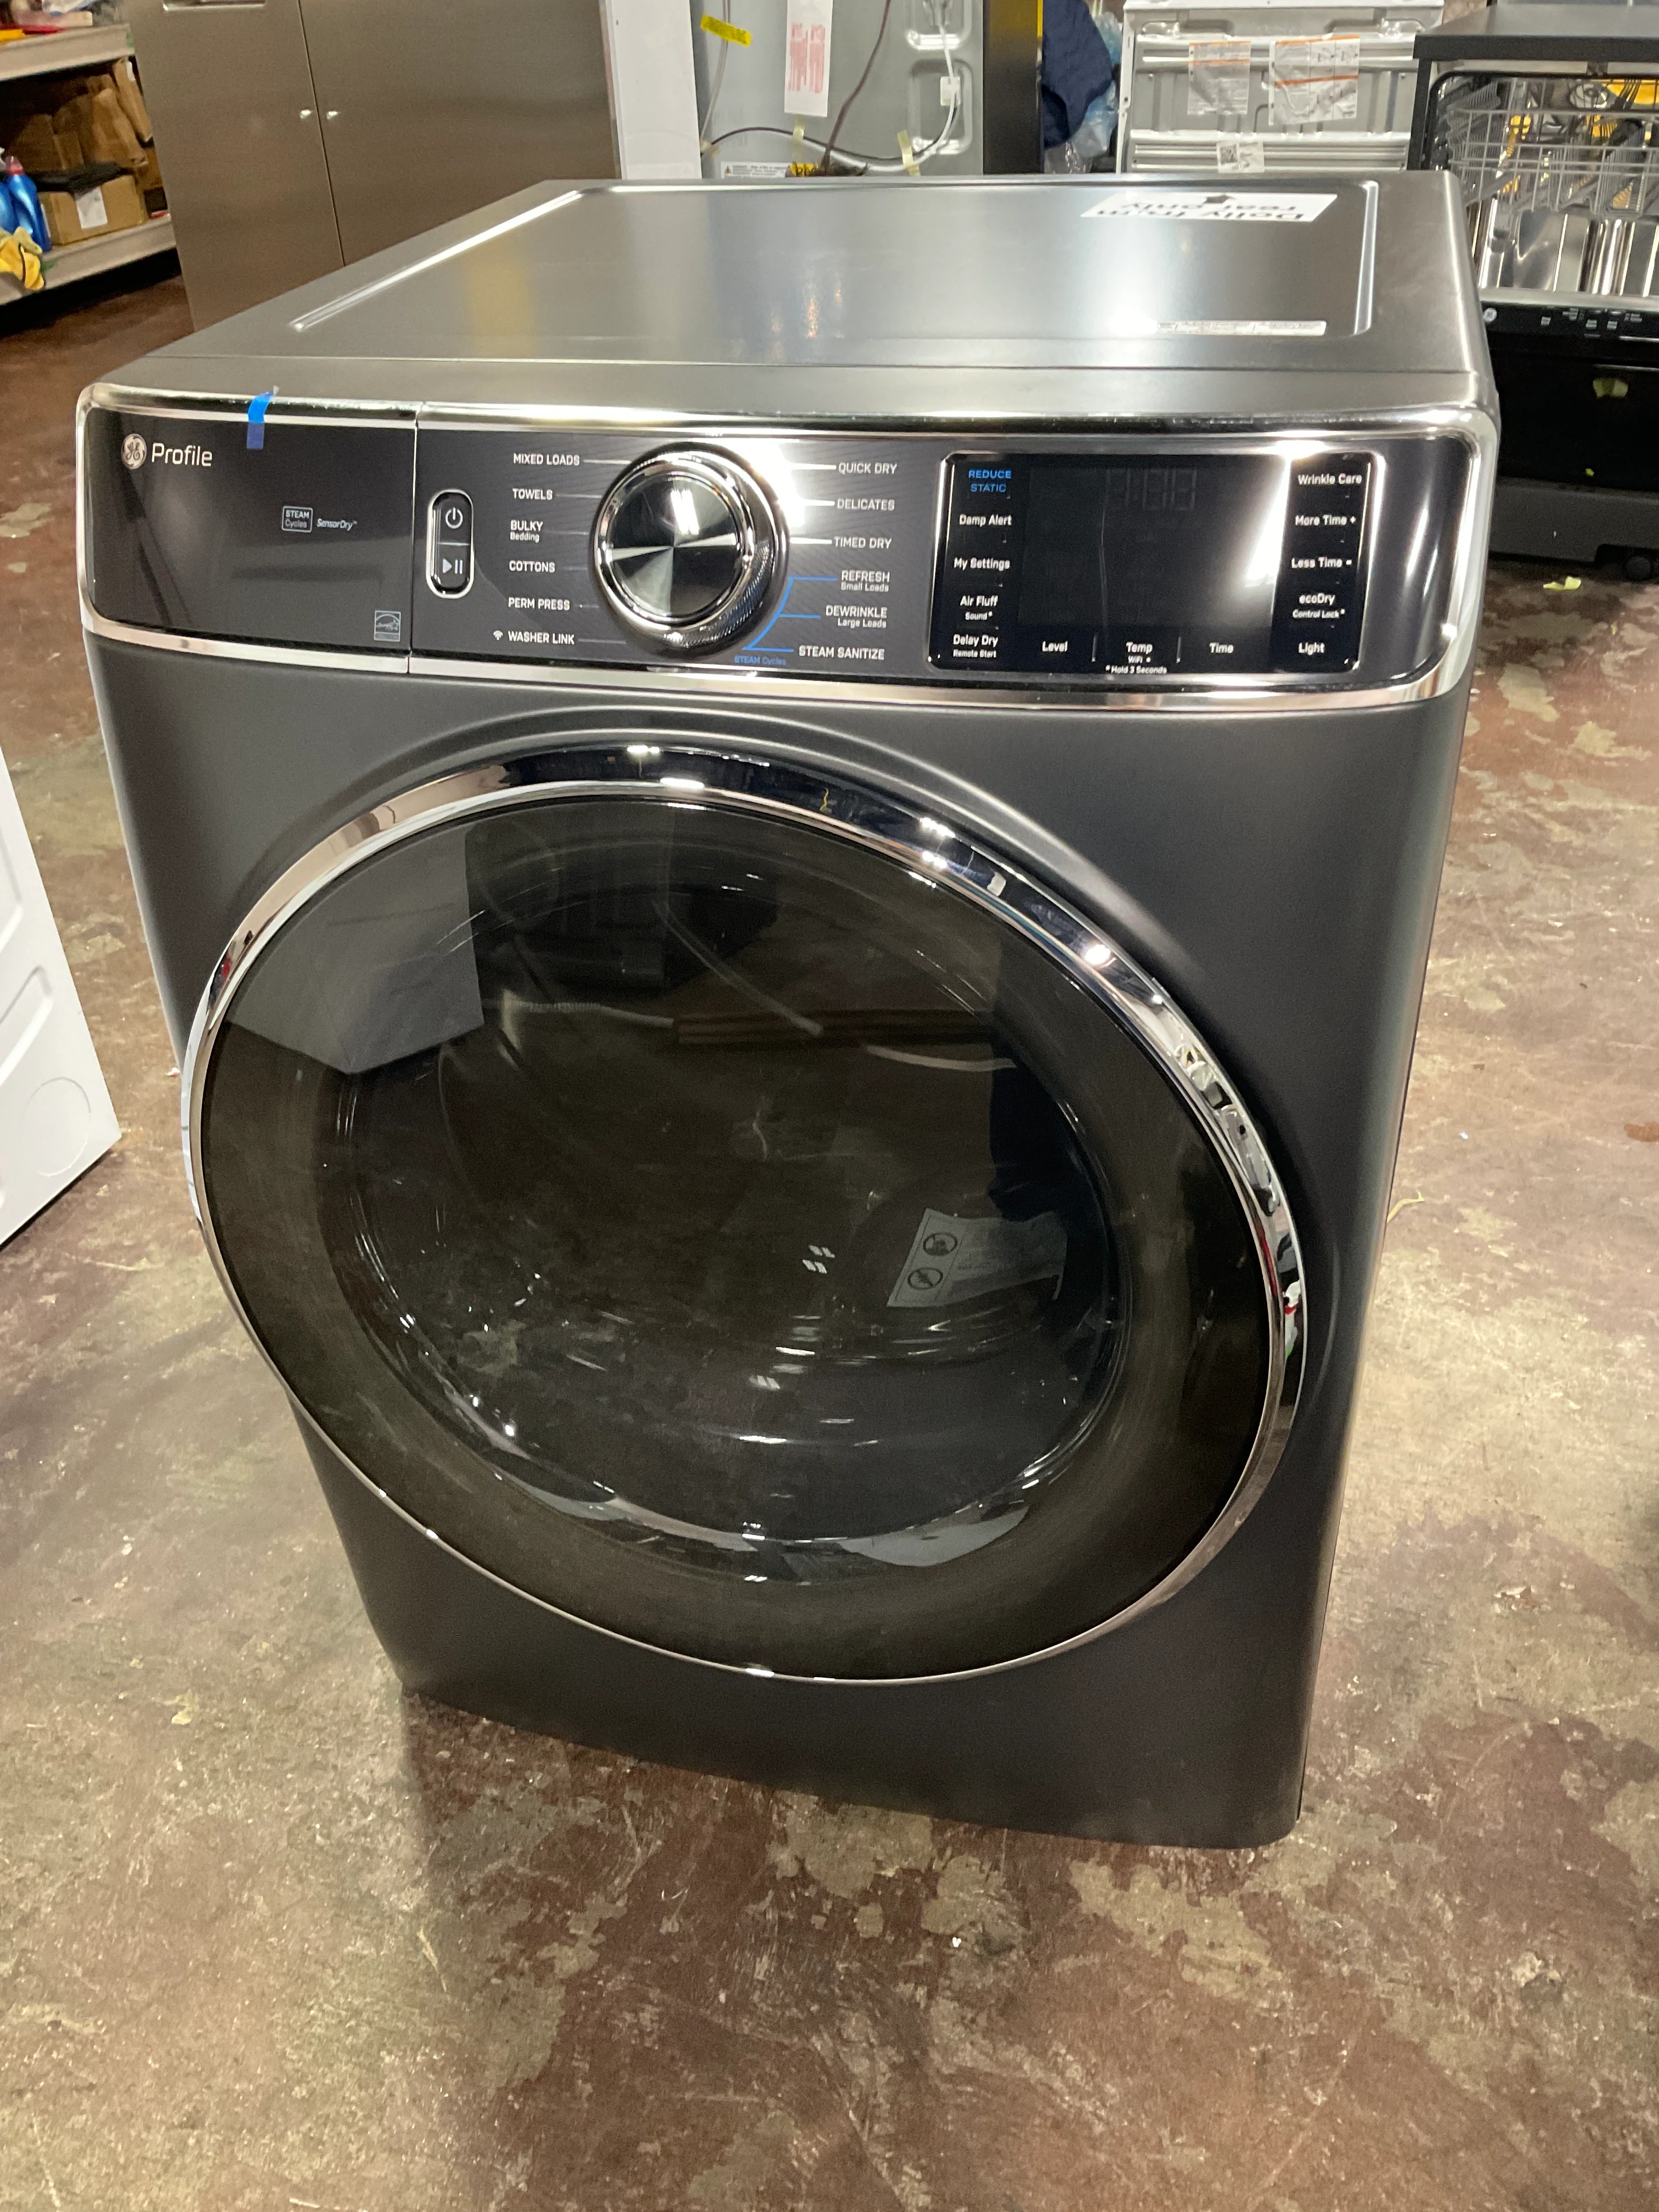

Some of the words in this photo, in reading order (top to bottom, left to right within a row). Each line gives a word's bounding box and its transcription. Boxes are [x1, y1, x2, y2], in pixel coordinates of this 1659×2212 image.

[151, 443, 212, 467] Profile
[513, 453, 544, 465] MIXED
[546, 454, 580, 466] LOADS
[838, 462, 871, 475] QUICK
[874, 462, 898, 475] DRY
[968, 469, 1012, 479] REDUCE
[1297, 473, 1335, 485] Wrinkle
[1338, 474, 1362, 484] Care
[512, 488, 553, 500] TOWELS
[970, 483, 1006, 493] STATIC
[837, 498, 895, 511] DELICATES
[285, 509, 310, 520] STEAM
[959, 514, 986, 527] Damp
[988, 514, 1012, 526] Alert
[1295, 515, 1320, 526] More
[1323, 514, 1347, 526] Time
[510, 520, 543, 532] BULKY
[510, 532, 540, 543] Bedding
[833, 536, 866, 548] TIMED
[869, 537, 892, 549] DRY
[509, 560, 555, 573] COTTONS
[953, 557, 968, 571] My
[970, 557, 1010, 572] Settings
[1291, 557, 1316, 568] Less
[1318, 556, 1342, 568] Time
[840, 569, 890, 583] REFRESH
[840, 581, 863, 591] Small
[865, 582, 889, 592] Loads
[508, 597, 535, 609] PERM
[538, 599, 570, 611] PRESS
[960, 595, 974, 606] Air
[976, 595, 998, 607] Fluff
[1299, 592, 1335, 606] ecoDry
[825, 605, 888, 619] DEWRINKLE
[1292, 609, 1321, 618] Control
[837, 617, 860, 629] Large
[862, 618, 887, 628] Loads
[507, 630, 550, 644] WASHER
[552, 633, 574, 645] LINK
[953, 634, 979, 647] Delay
[981, 635, 998, 647] Dry
[1042, 641, 1068, 652] Level
[1126, 641, 1153, 654] Temp
[1209, 642, 1234, 653] Time
[1298, 642, 1325, 656] Light
[799, 645, 834, 658] STEAM
[837, 647, 885, 661] SANITIZE
[979, 649, 997, 658] Start
[734, 655, 760, 664] STEAM
[1111, 665, 1128, 674] Hold
